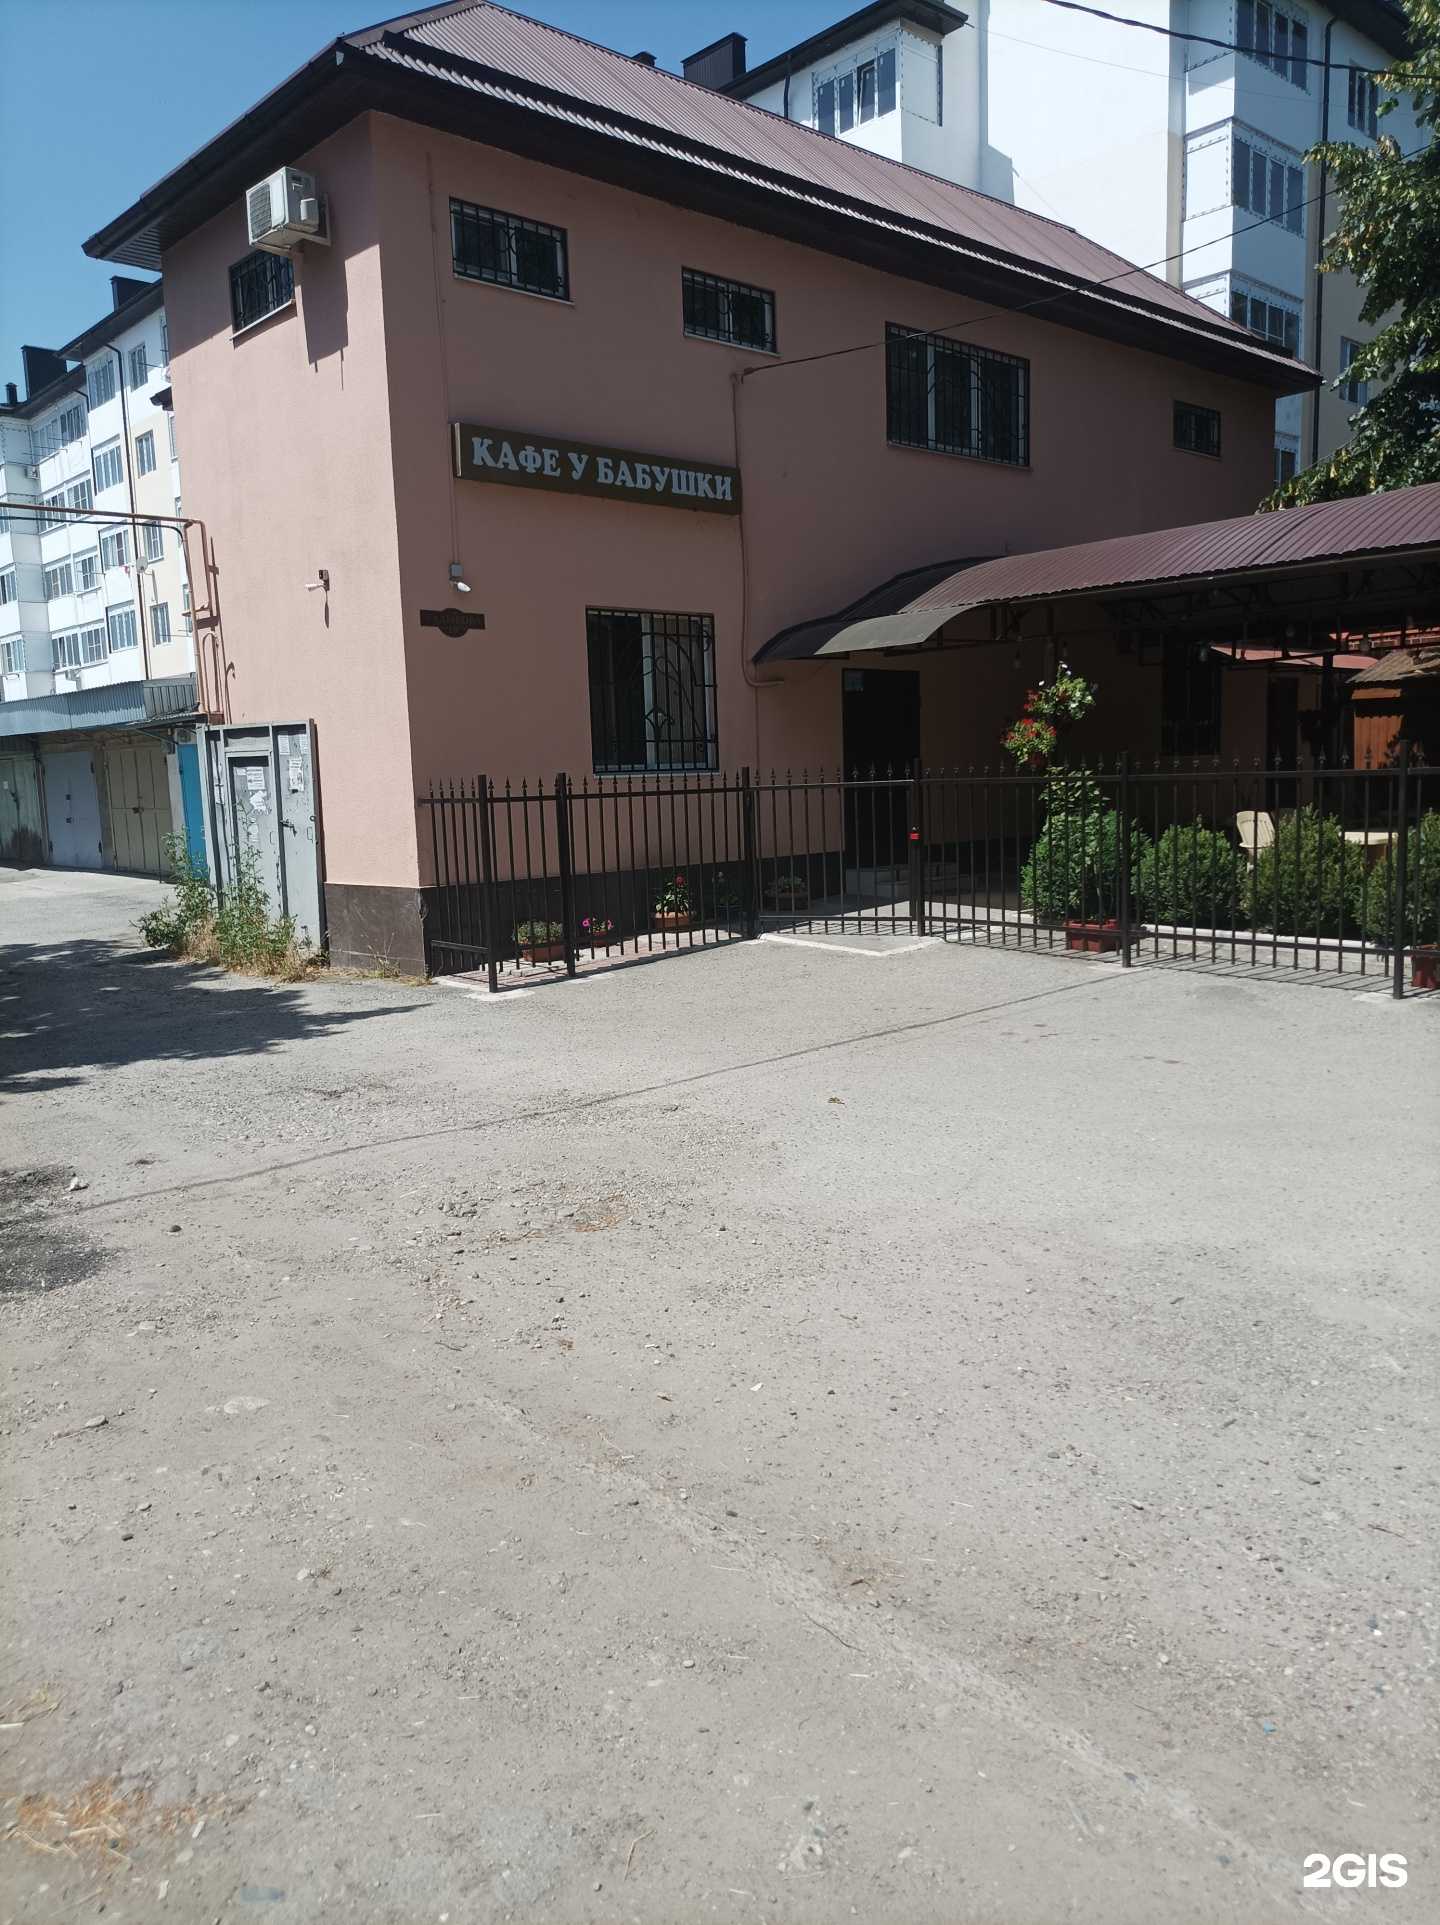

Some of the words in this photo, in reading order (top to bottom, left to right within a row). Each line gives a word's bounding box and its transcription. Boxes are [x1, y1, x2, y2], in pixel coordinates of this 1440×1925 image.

[471, 437, 561, 477] КАФЕ
[568, 452, 589, 480] У
[596, 456, 733, 500] БАБУШКИ
